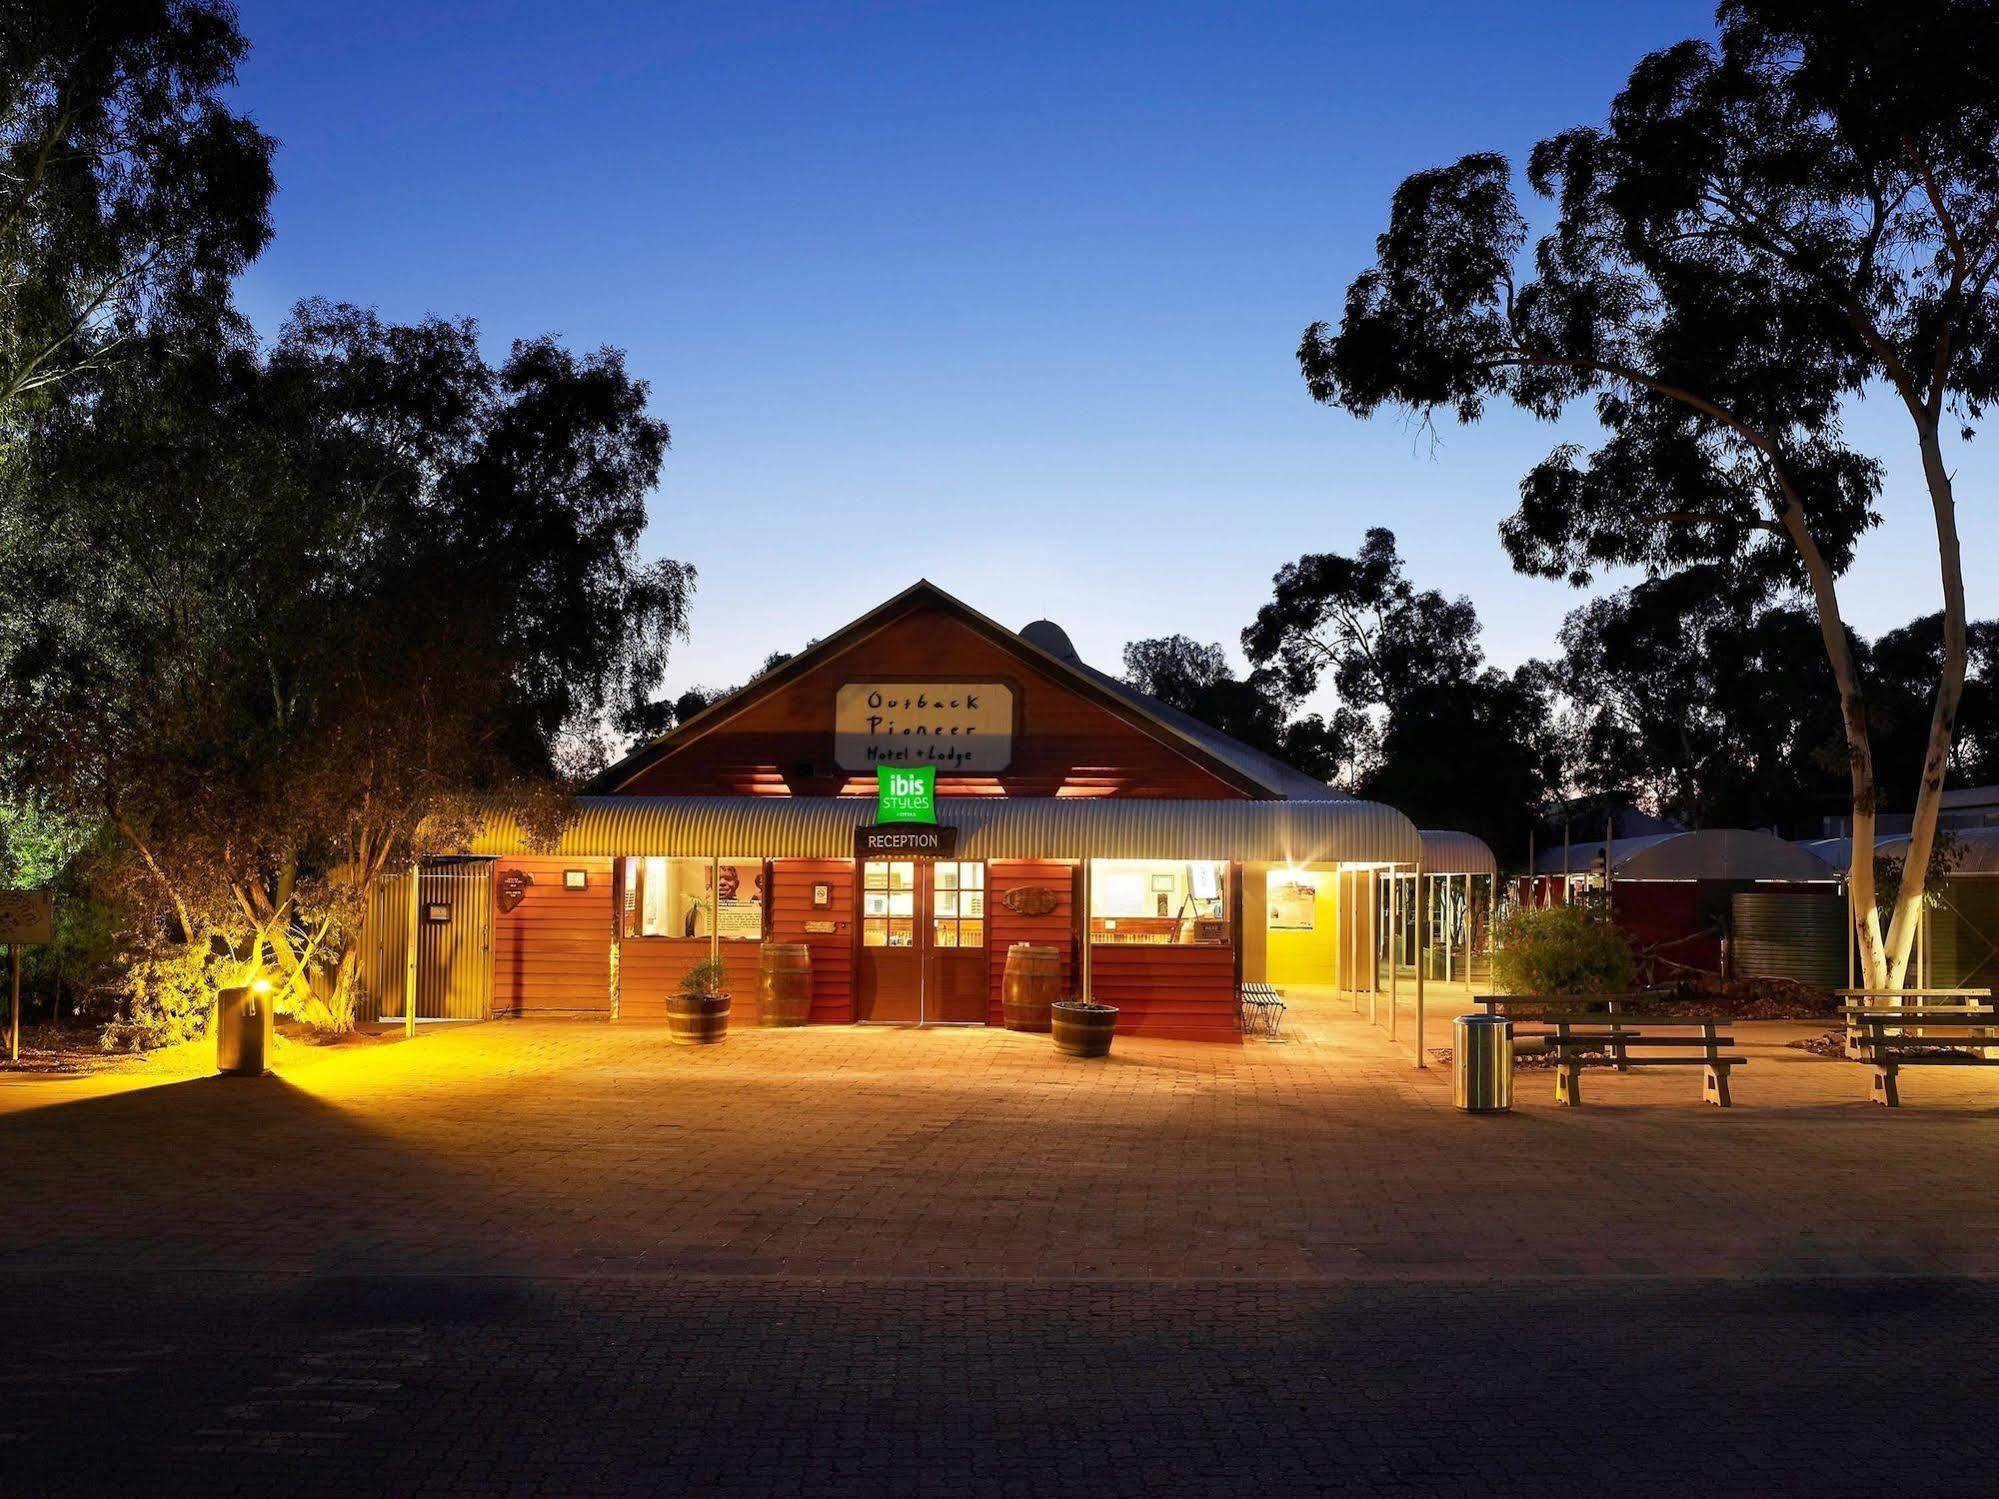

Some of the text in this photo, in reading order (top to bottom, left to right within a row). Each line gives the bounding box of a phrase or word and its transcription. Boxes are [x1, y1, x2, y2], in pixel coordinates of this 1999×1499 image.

[868, 691, 978, 709] Outback
[866, 715, 976, 736] Pioneer
[867, 745, 909, 760] Hotel
[928, 745, 972, 768] Lodge
[890, 774, 925, 797] ibis
[868, 834, 938, 848] RECEPTION
